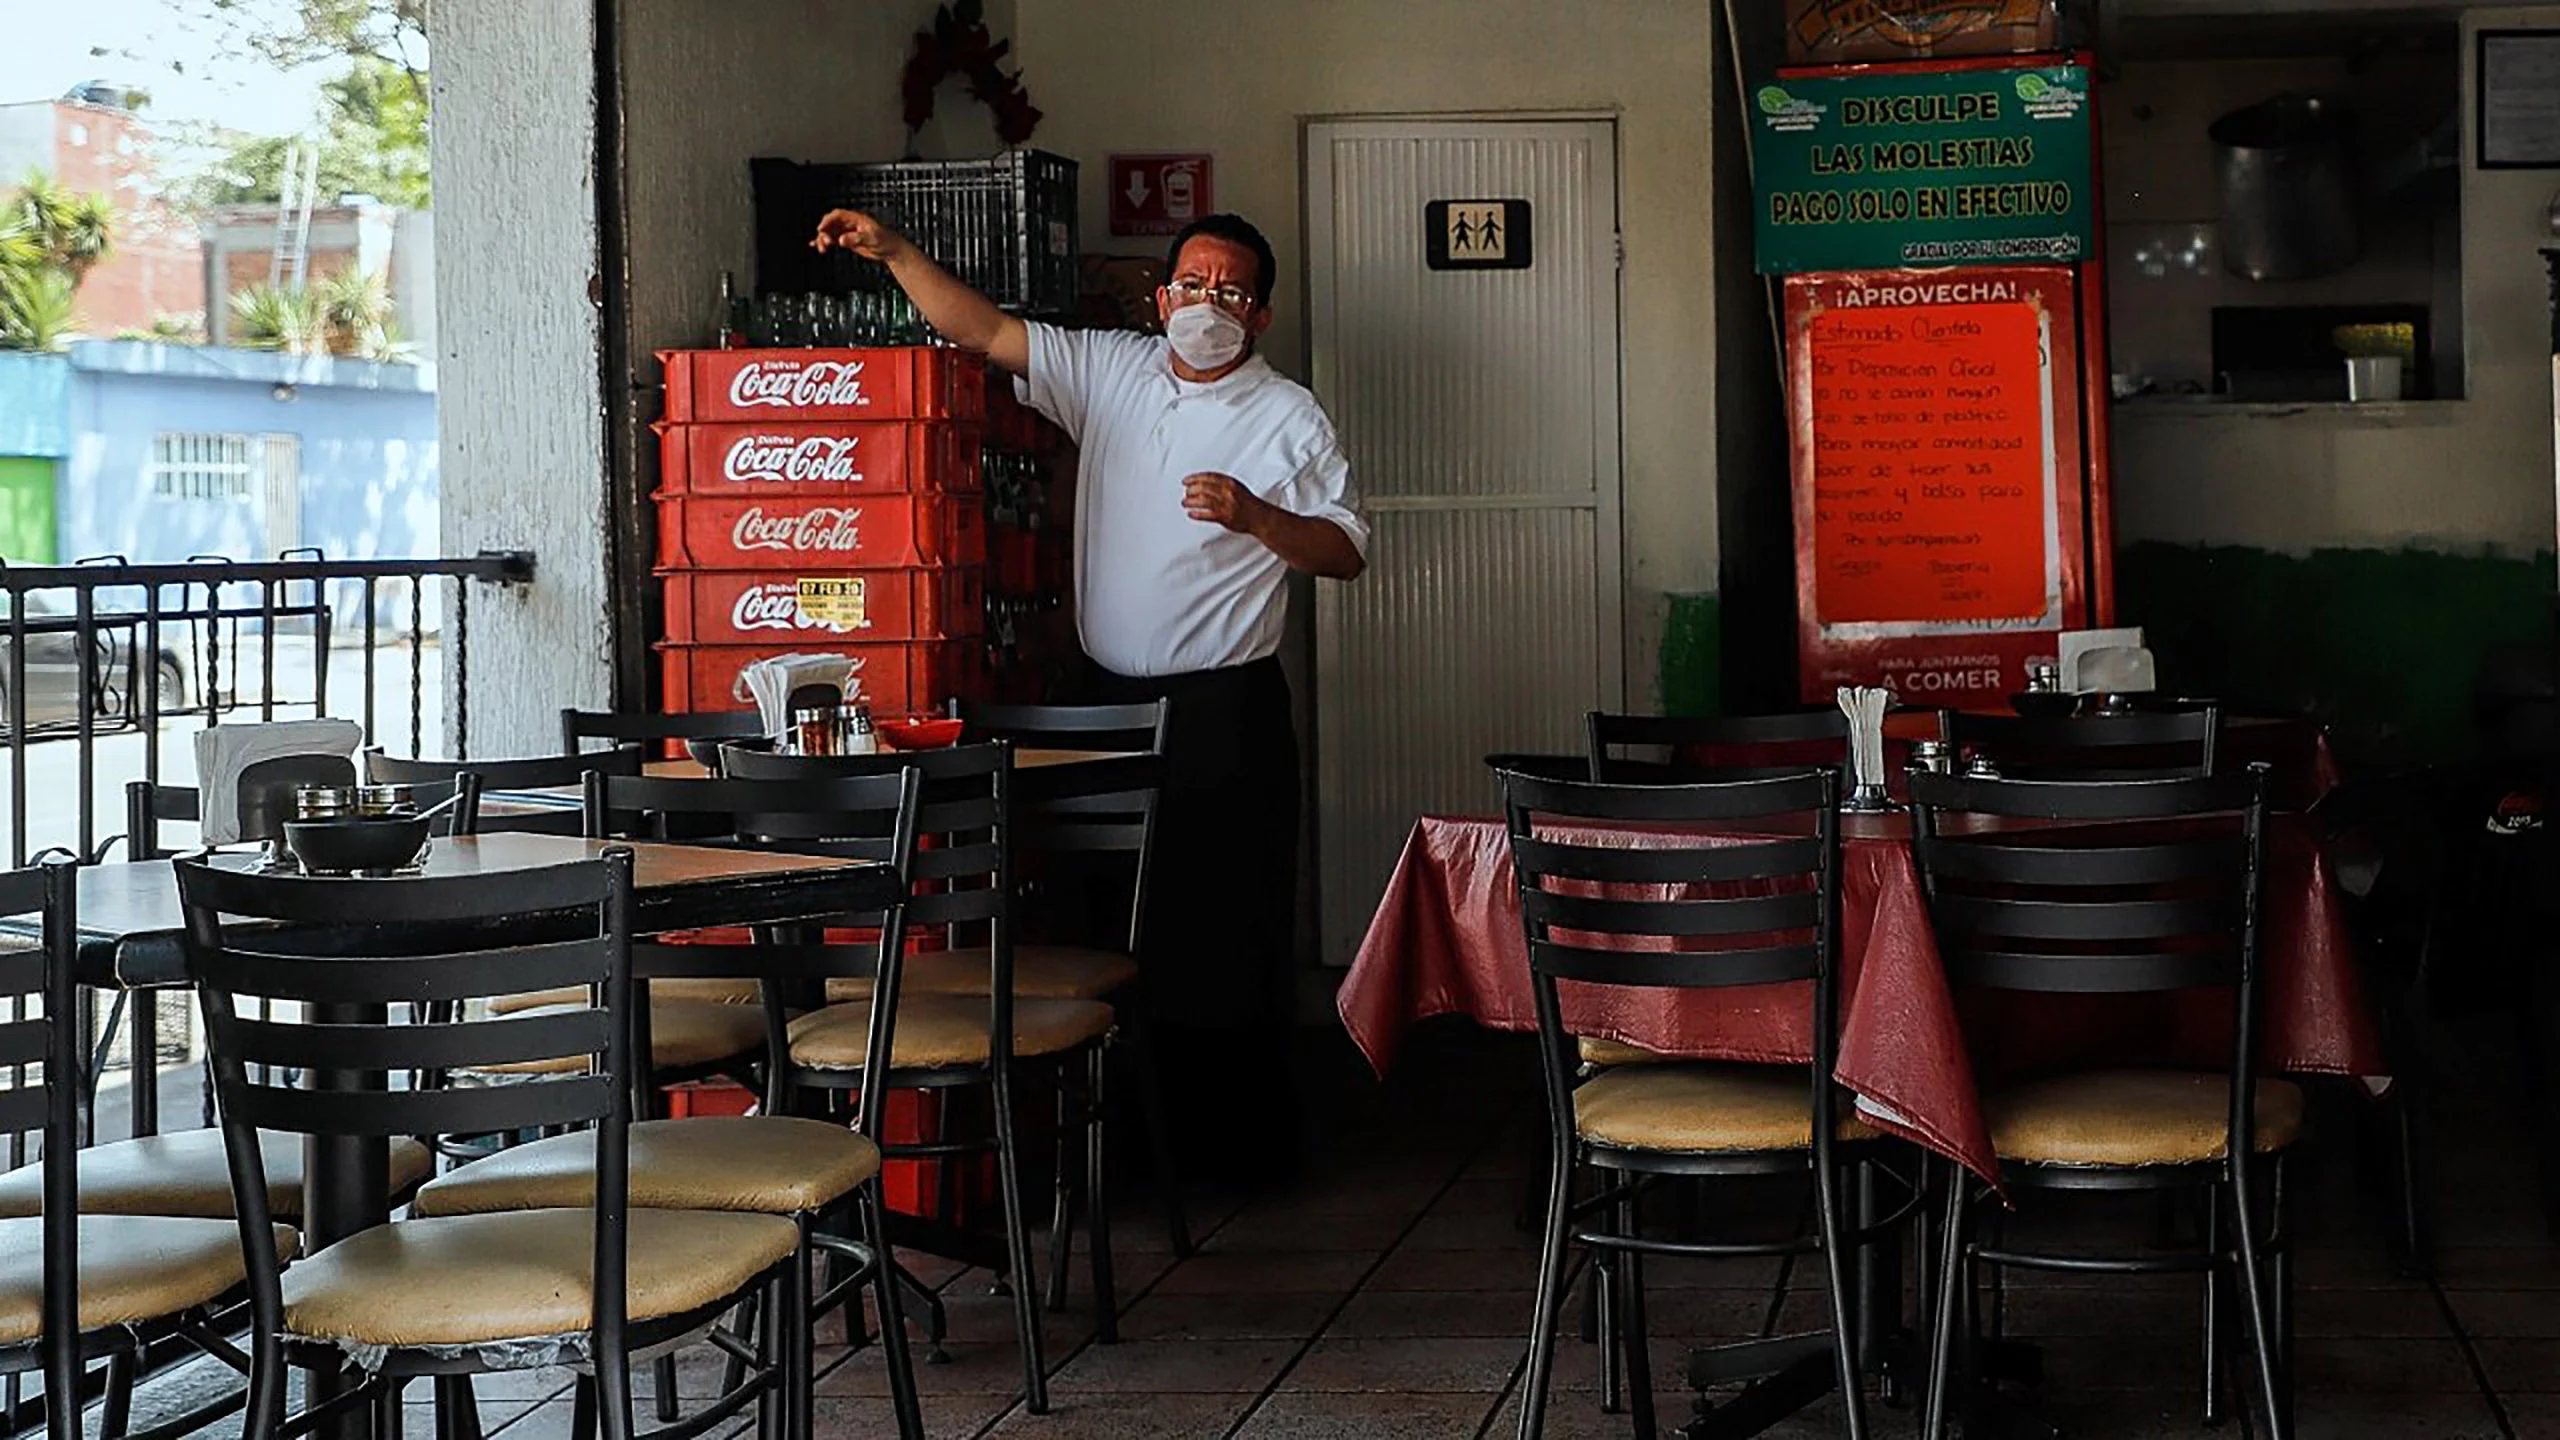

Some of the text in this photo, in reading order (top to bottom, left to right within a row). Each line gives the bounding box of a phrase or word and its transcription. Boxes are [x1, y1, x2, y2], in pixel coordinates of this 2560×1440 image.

[1841, 92, 2000, 126] DISCULPE
[1811, 136, 2034, 174] LAS MOLESTIAS
[1770, 181, 2071, 224] PAGO SOLO EN EFECTIVO
[1836, 281, 2016, 308] ¡APROVECHA!
[730, 361, 864, 407] Coca-Cola
[724, 437, 859, 481] Coca-Cola
[1978, 484, 2024, 502] para
[733, 507, 863, 551] Coca-Cola
[801, 582, 817, 595] 07
[1882, 669, 2001, 691] A COMER
